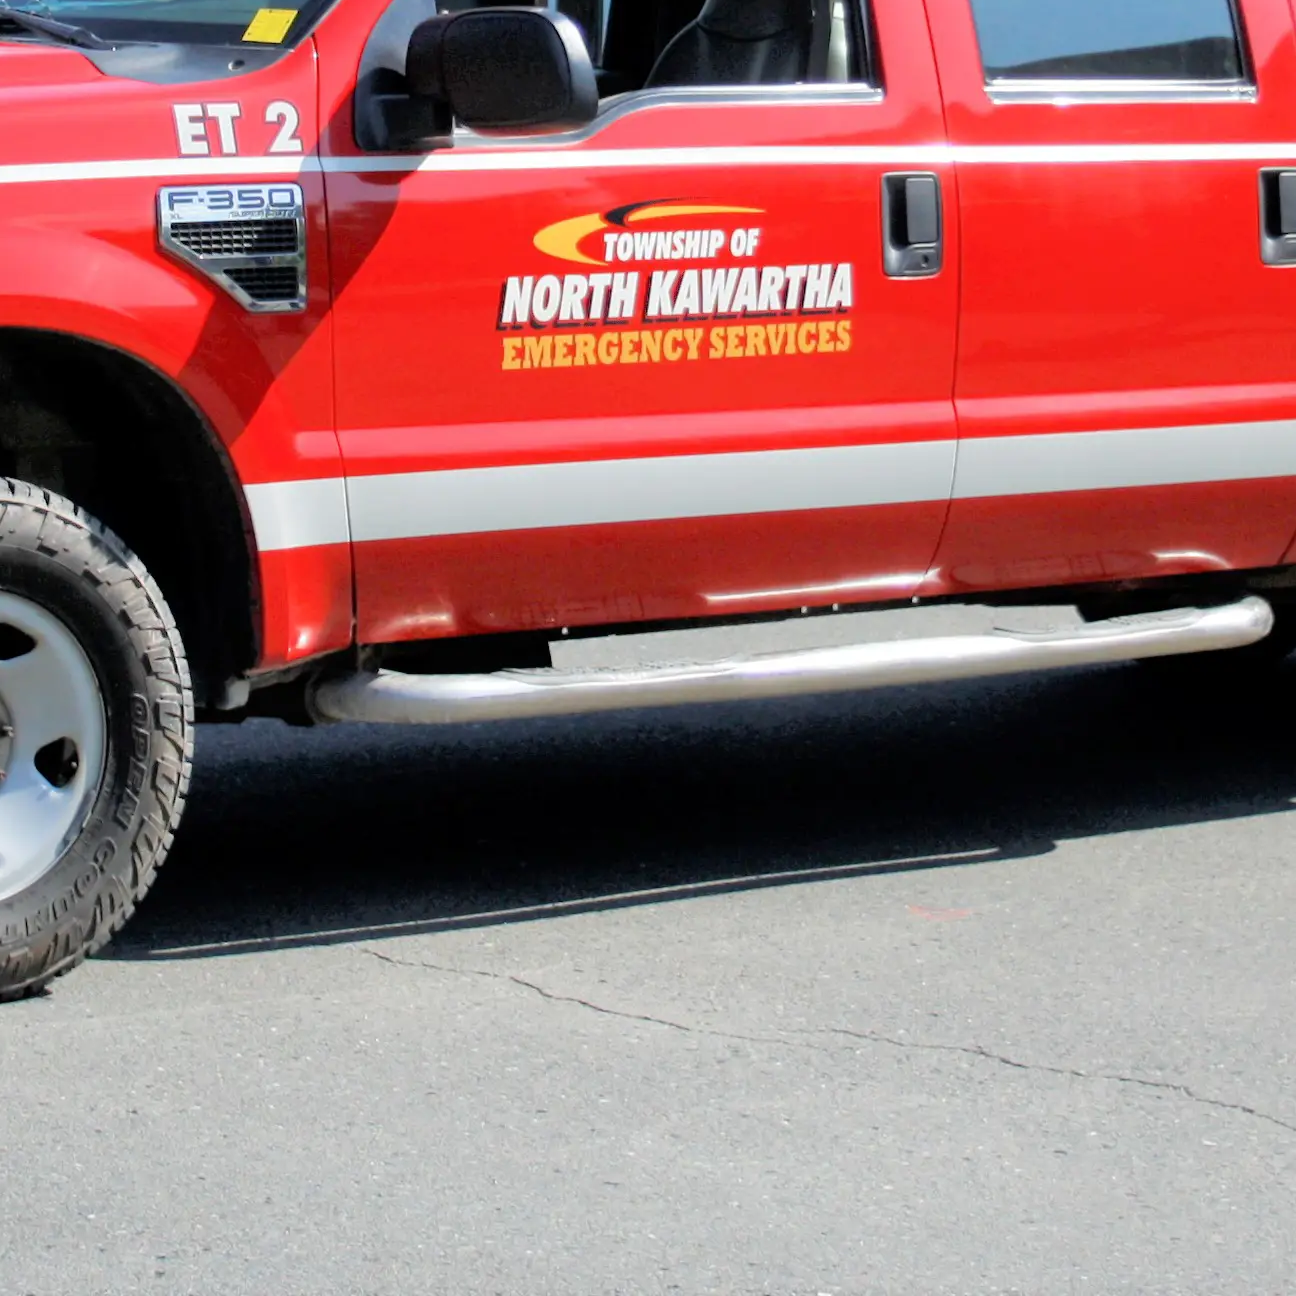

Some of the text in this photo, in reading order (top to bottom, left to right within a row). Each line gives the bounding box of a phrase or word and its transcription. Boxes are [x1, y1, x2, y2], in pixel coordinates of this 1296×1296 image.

[172, 100, 304, 157] ET 2
[603, 228, 760, 262] TOWNSHIP OF
[499, 263, 853, 327] NORTH KAWARTHA
[501, 320, 852, 371] EMERGENCY SERVICES
[115, 692, 150, 831] OPEN
